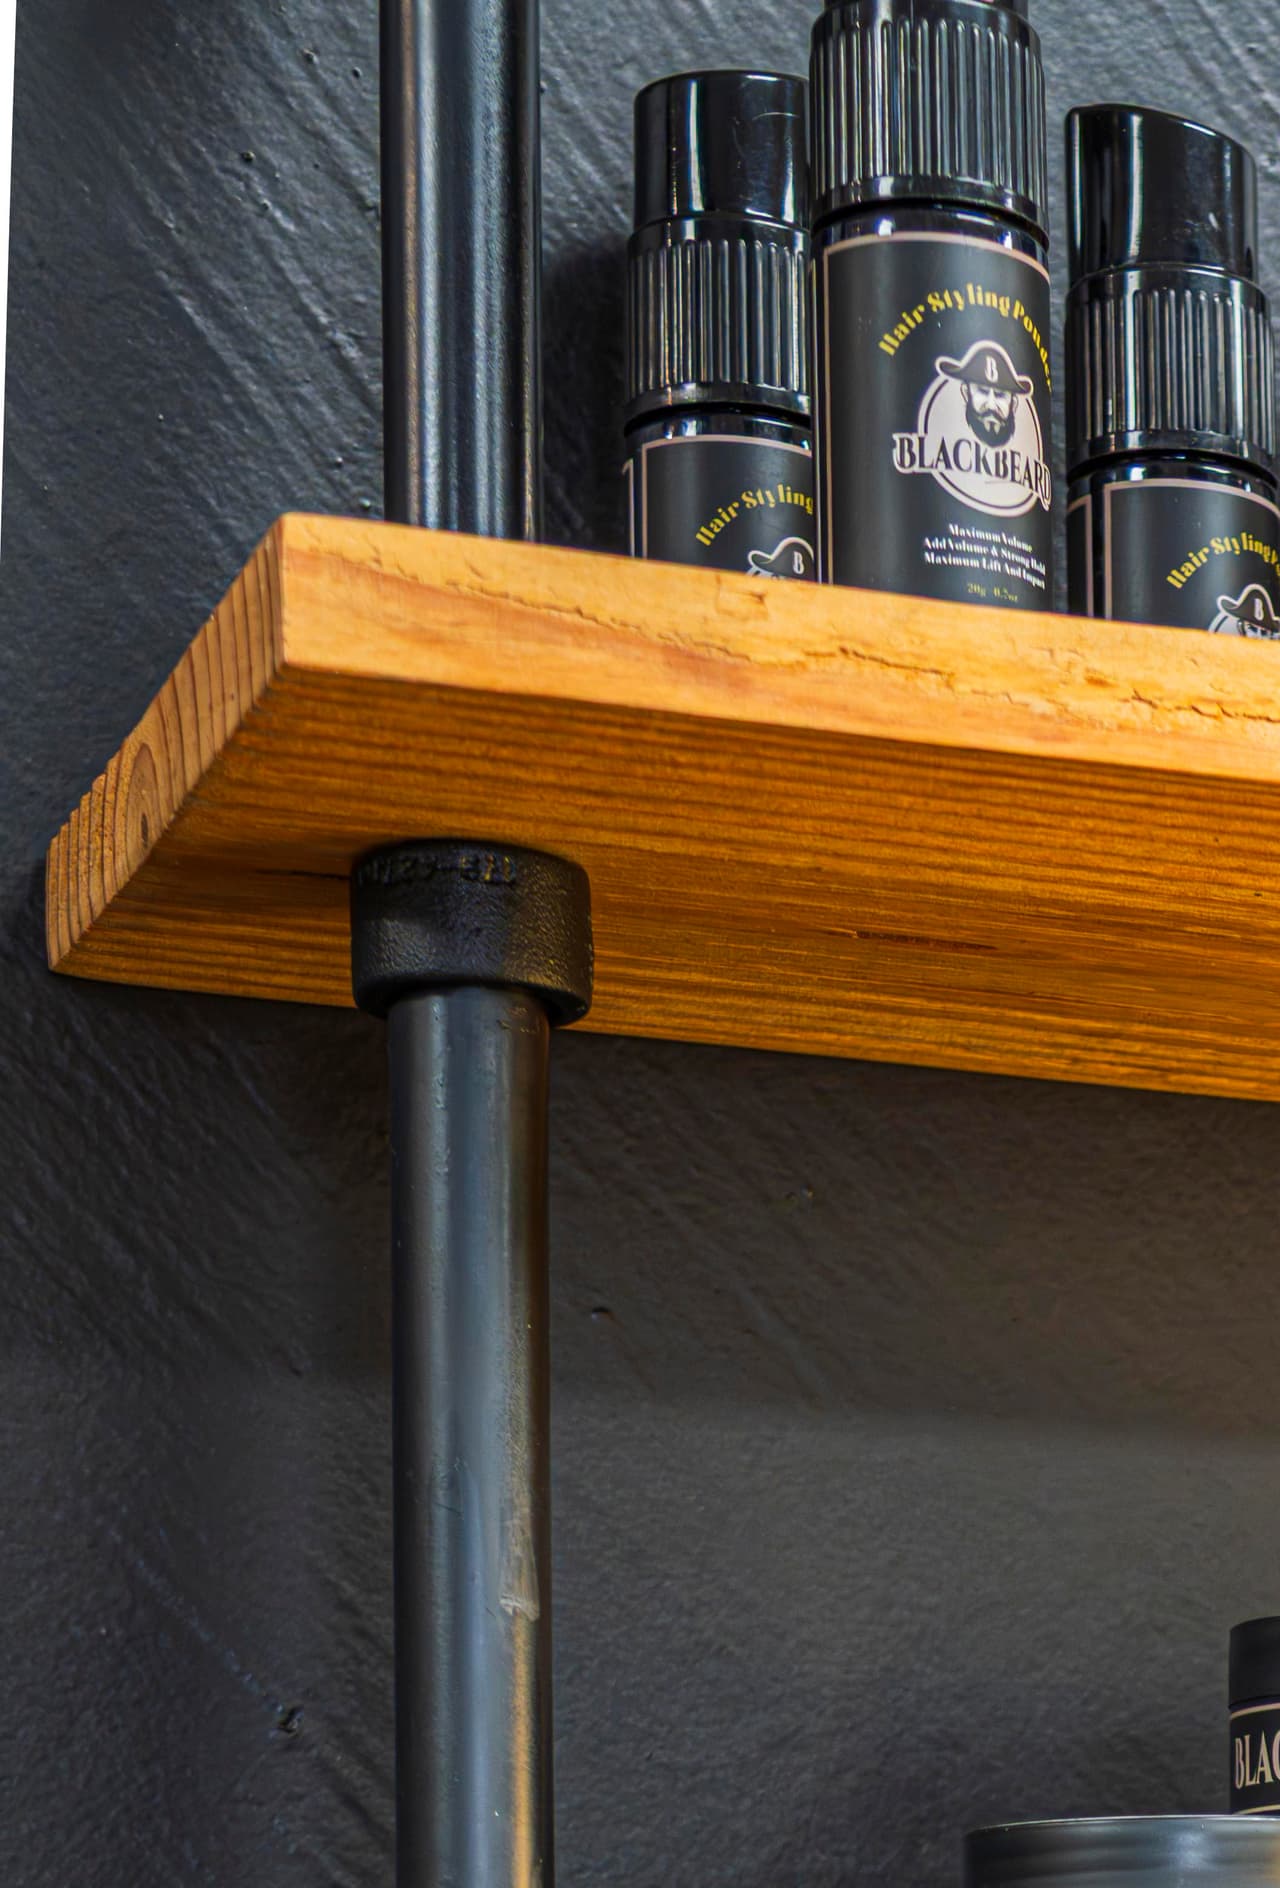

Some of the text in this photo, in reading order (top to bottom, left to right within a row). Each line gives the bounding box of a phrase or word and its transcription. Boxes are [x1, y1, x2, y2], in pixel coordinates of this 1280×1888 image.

[879, 283, 1010, 356] Hair Styling
[894, 435, 1051, 504] BLACKBEARD
[695, 500, 741, 547] Hair
[949, 523, 1000, 542] Maximum
[924, 552, 979, 568] Maximum
[1167, 548, 1208, 590] Hair
